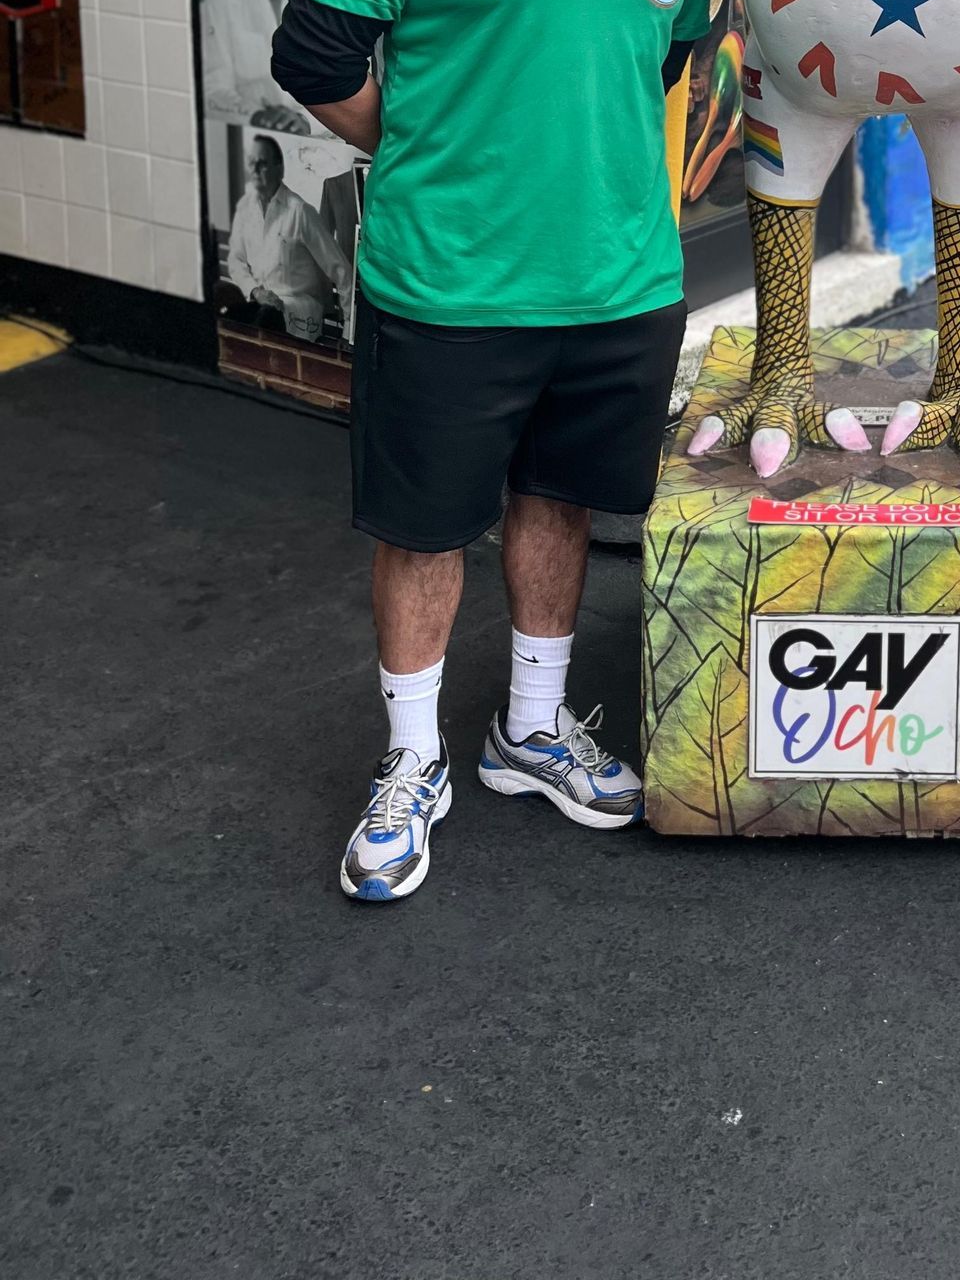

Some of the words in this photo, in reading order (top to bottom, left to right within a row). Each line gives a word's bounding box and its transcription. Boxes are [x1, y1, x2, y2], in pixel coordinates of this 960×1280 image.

[772, 501, 879, 512] PLEASE
[889, 504, 929, 512] DO
[783, 509, 828, 522] SIT
[835, 511, 877, 522] OR
[768, 628, 952, 710] GAY
[772, 666, 945, 766] Ocho
